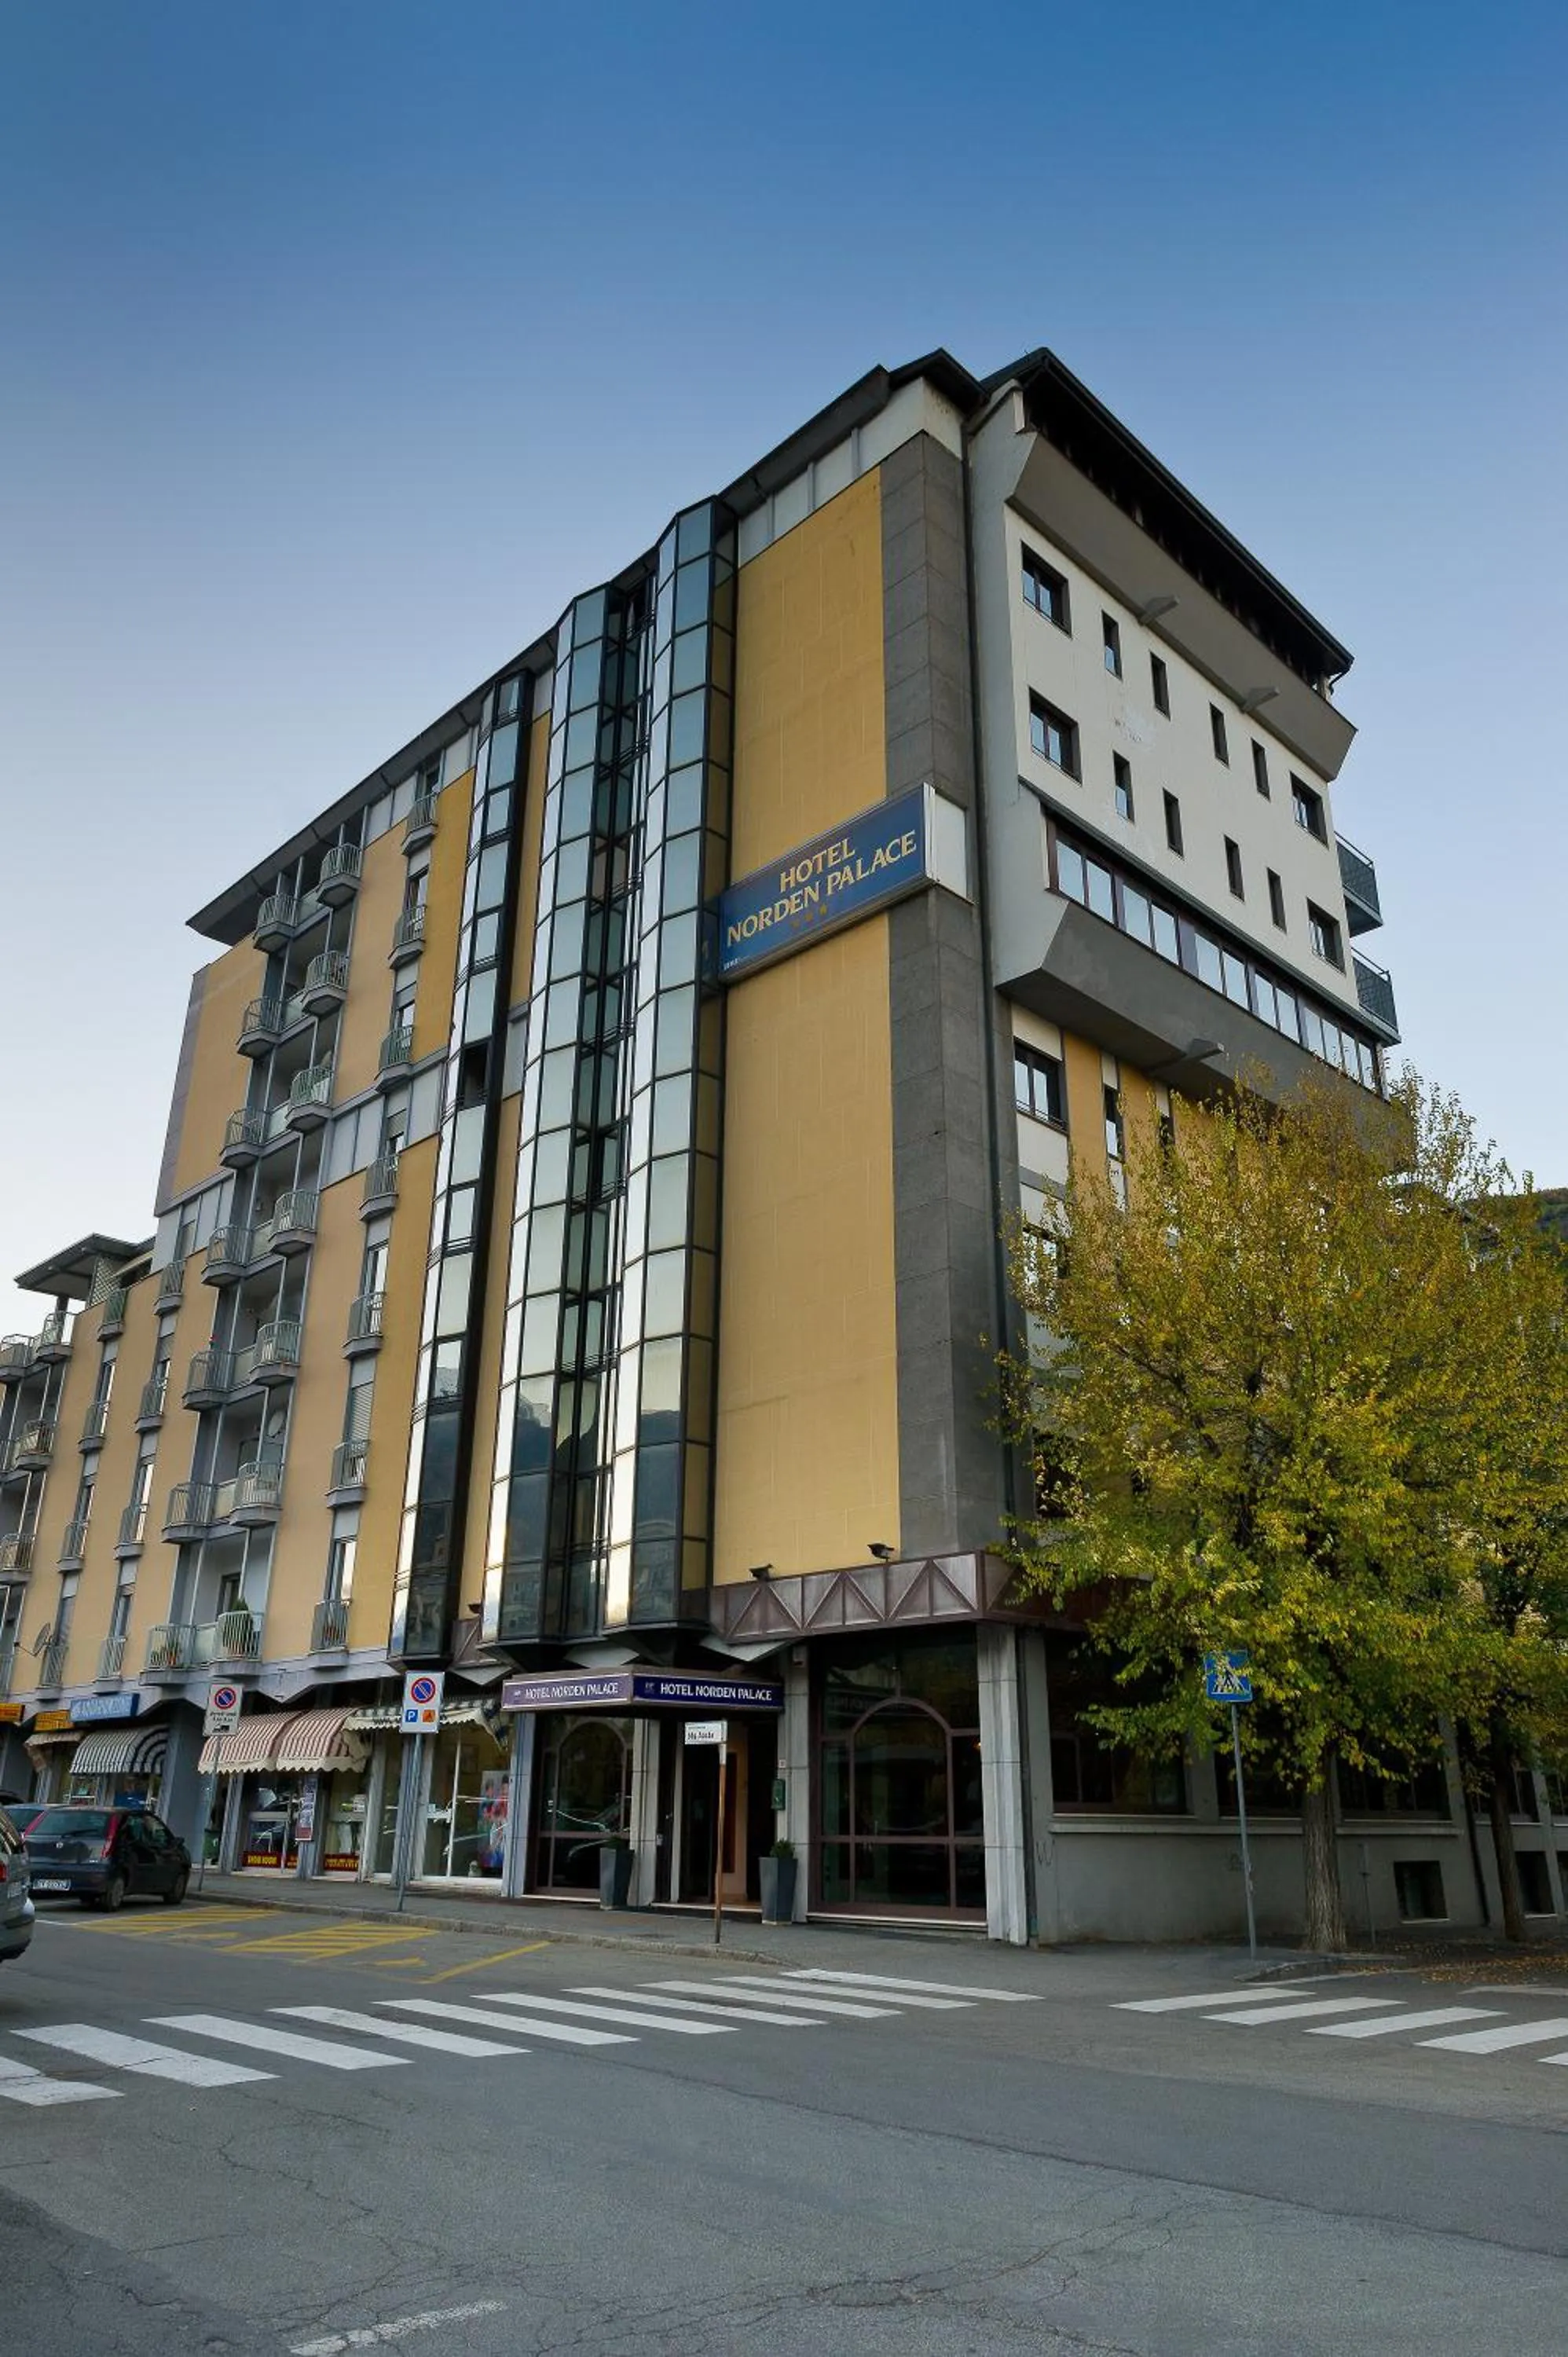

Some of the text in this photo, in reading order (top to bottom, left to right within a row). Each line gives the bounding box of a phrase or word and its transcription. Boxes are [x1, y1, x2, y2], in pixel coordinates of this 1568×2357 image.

[779, 838, 855, 893] HOTEL
[727, 830, 918, 948] NORDEN PALACE
[525, 1688, 550, 1699] HOTEL
[550, 1685, 586, 1698] NORDEN
[587, 1682, 619, 1695] PALACE
[661, 1682, 694, 1695] HOTEL
[695, 1685, 736, 1699] NORDEN
[738, 1688, 772, 1701] PALACE
